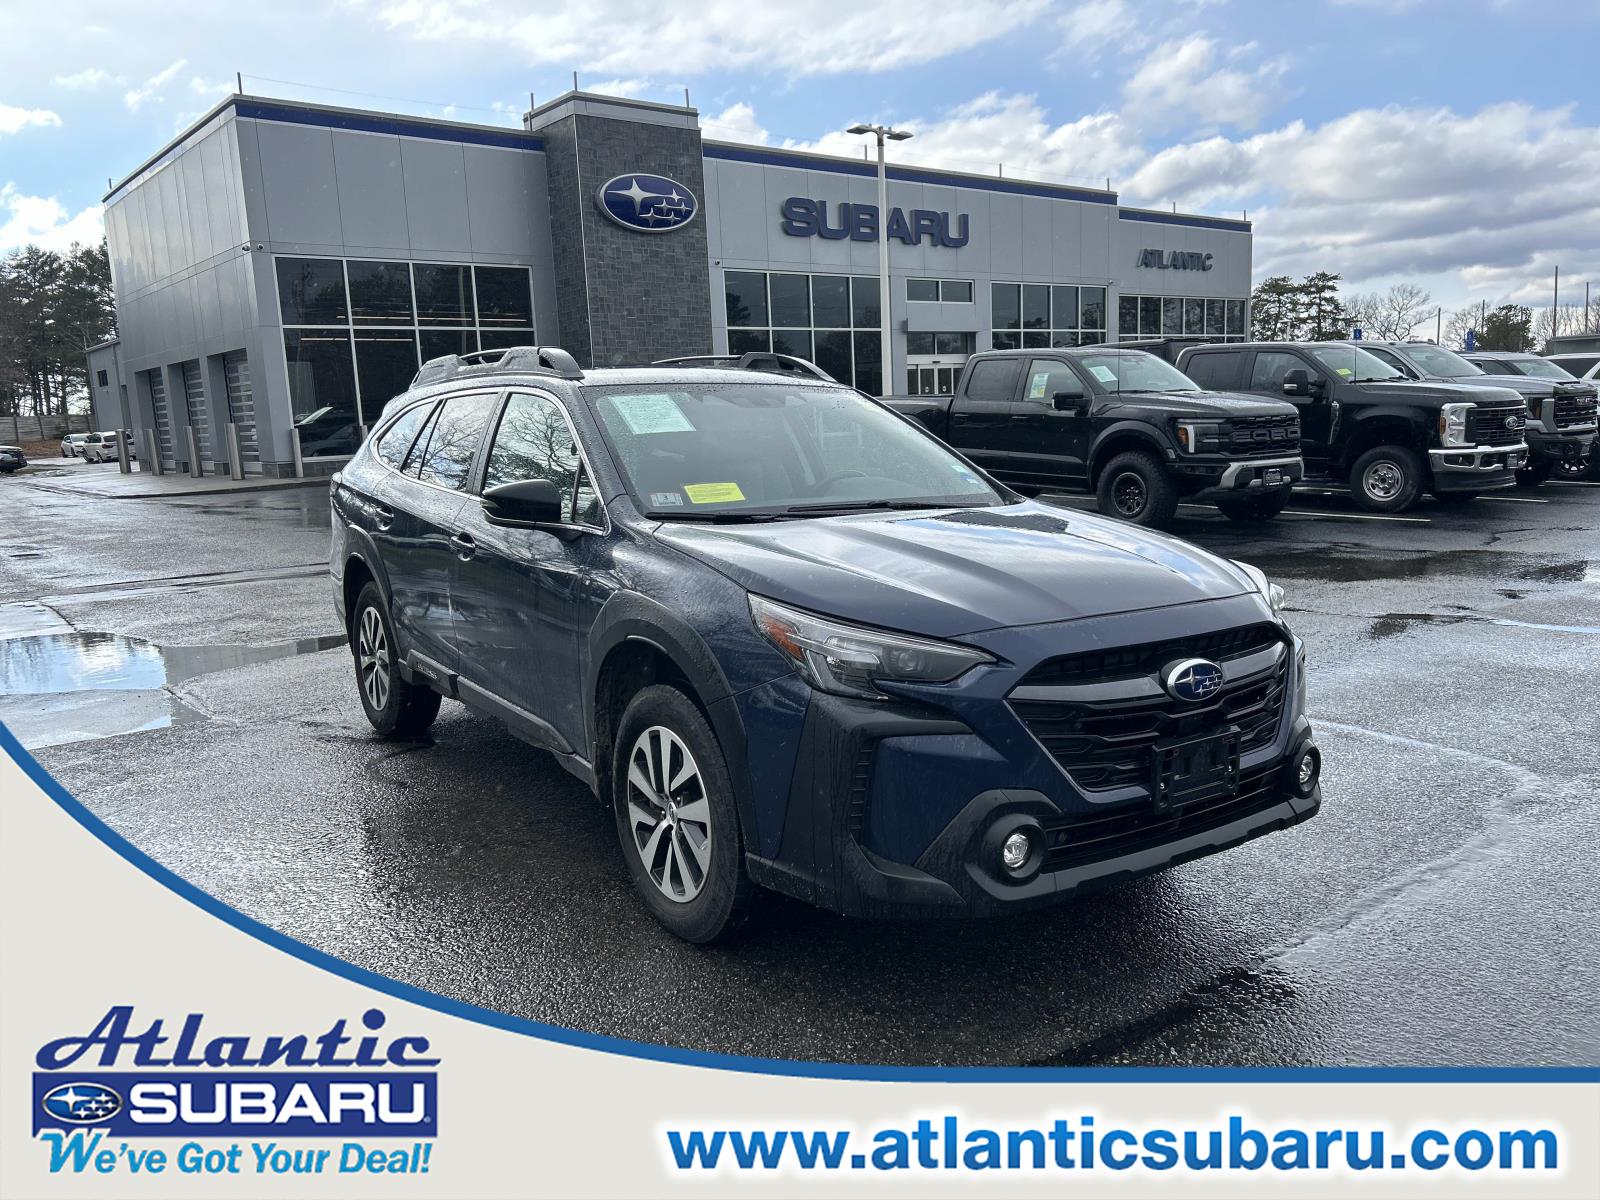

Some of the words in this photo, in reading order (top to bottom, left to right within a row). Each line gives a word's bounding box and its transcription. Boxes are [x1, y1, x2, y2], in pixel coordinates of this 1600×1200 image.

[782, 197, 969, 248] SUBARU
[1136, 248, 1213, 271] ATLANTIC
[1231, 428, 1300, 442] FORD
